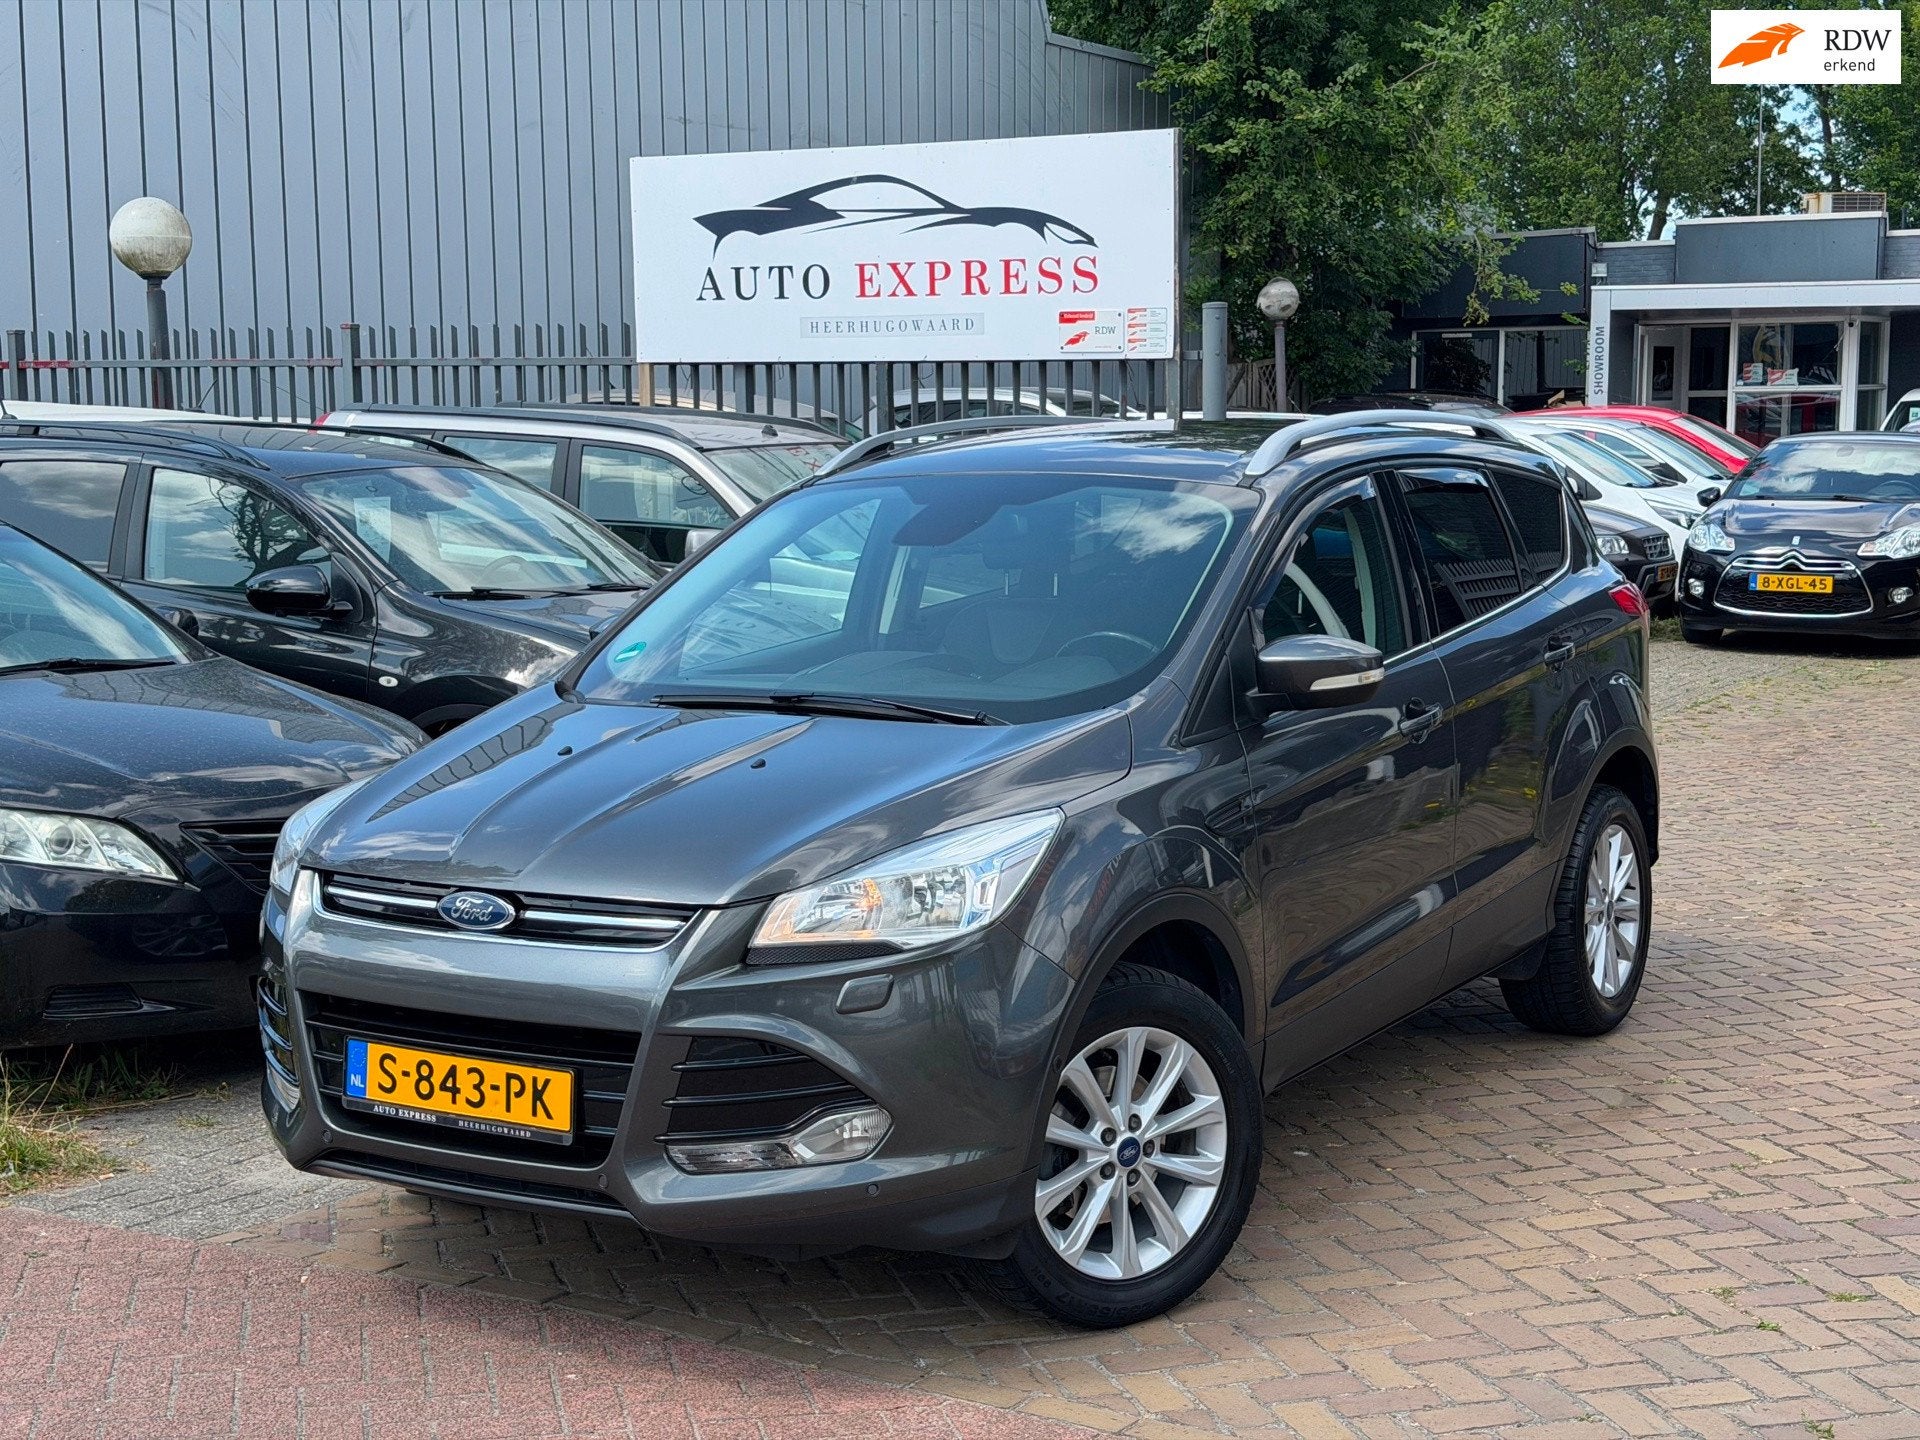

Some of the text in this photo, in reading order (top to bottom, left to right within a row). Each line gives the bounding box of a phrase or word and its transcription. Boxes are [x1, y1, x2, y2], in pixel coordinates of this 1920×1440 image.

[696, 255, 1100, 301] AUTO EXPRESS
[809, 317, 976, 335] HEERHUGOWAARD
[1094, 326, 1117, 335] RDW
[1593, 326, 1605, 395] SHOWROOM
[1762, 576, 1828, 591] 8-XGL-45
[450, 896, 494, 922] Ford
[350, 1074, 365, 1088] NL
[377, 1052, 555, 1121] S-843-PK
[373, 1105, 532, 1138] AUTO EXPRESS HEERHUGOWAARD
